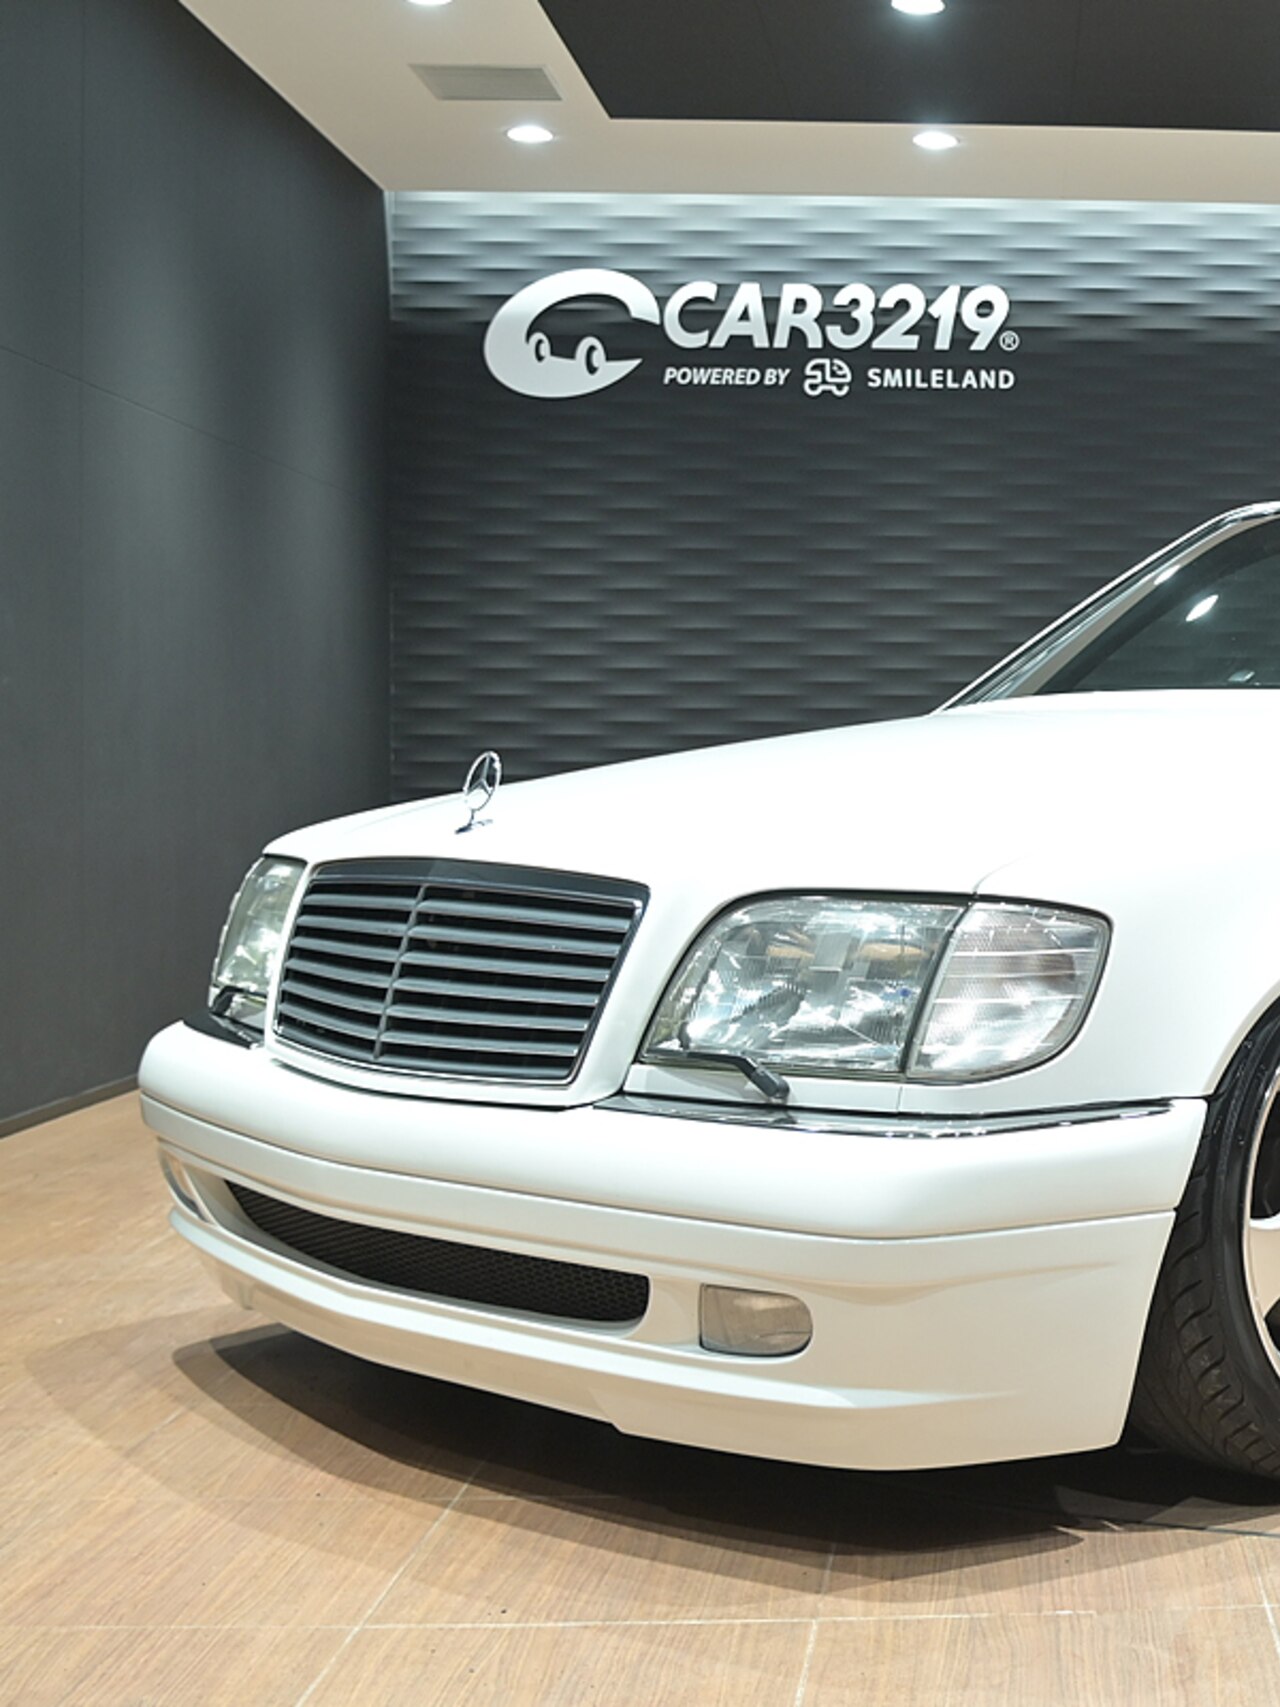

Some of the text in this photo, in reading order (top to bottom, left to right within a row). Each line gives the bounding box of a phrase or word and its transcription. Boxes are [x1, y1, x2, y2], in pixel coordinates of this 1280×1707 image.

[663, 366, 1016, 390] POWERED BY SMILELAND
